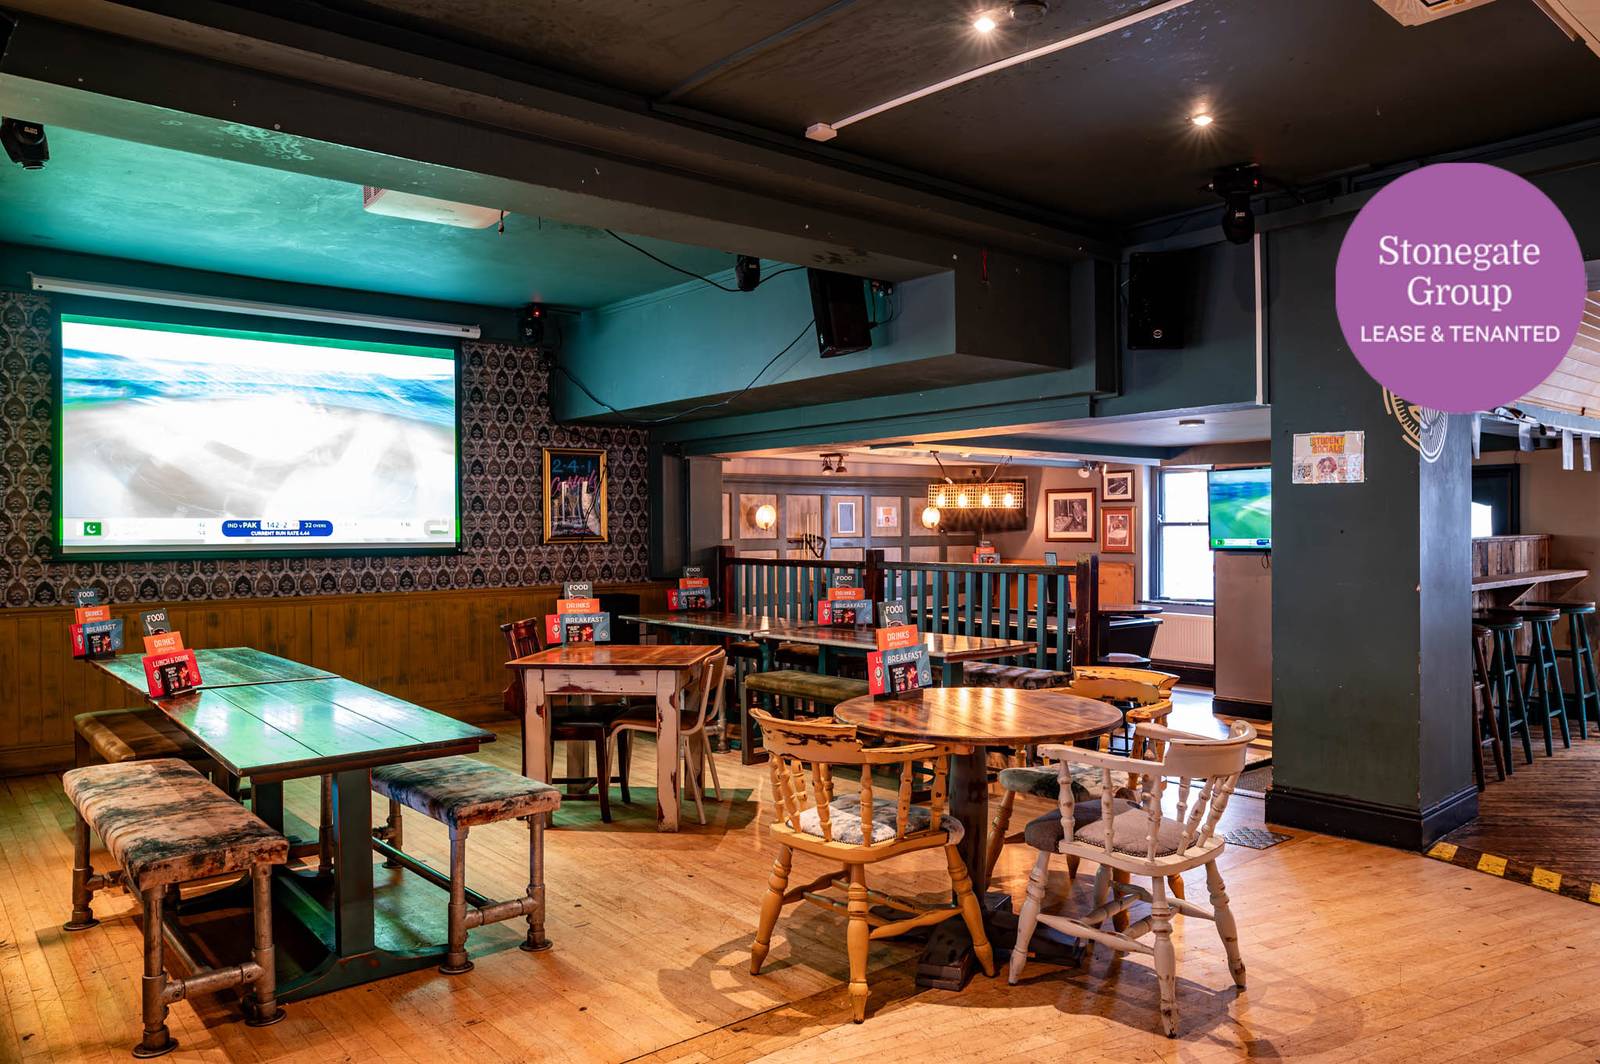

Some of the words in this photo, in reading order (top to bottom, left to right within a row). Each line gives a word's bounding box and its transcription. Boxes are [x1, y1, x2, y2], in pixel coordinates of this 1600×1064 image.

[78, 590, 95, 598] FOOD
[84, 610, 104, 618] DRINKS
[885, 604, 904, 615] FOOD
[146, 613, 165, 622] FOOD
[565, 616, 604, 624] BREAKFAST
[86, 623, 117, 634] BREAKFAST
[887, 630, 910, 641] DRINKS
[153, 637, 175, 648] DRINKS
[152, 657, 171, 668] LUNCH
[174, 654, 190, 663] DRINK
[887, 650, 923, 664] BREAKFAST
